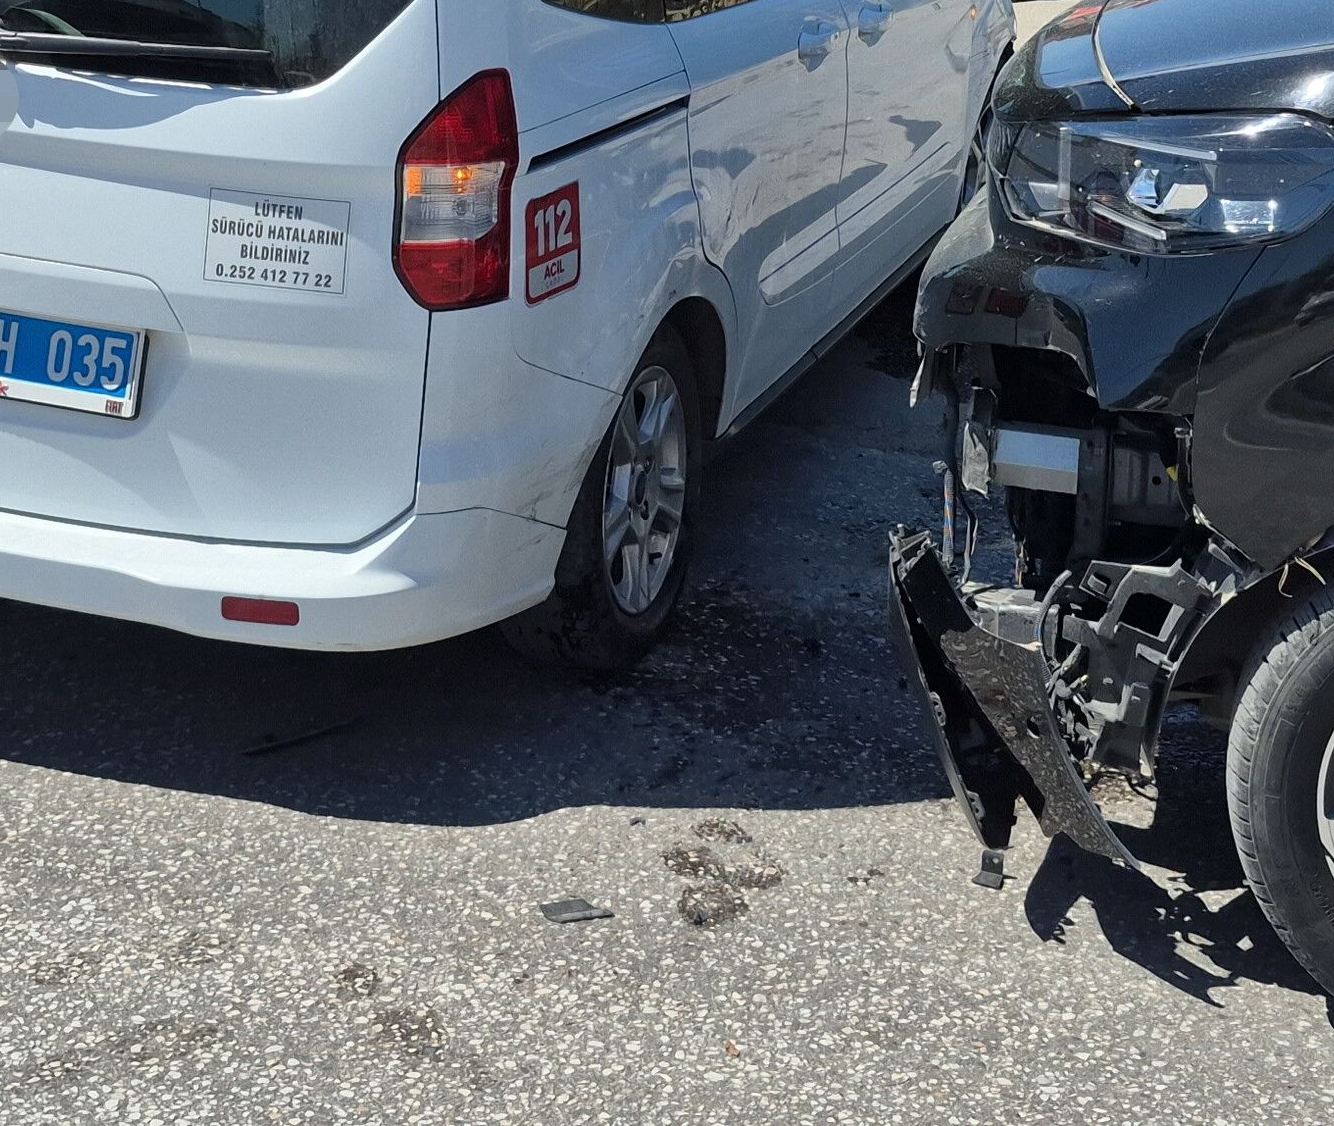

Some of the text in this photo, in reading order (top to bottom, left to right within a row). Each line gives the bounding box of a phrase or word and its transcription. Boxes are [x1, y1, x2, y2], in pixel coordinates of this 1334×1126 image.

[254, 199, 303, 221] LÜTFEN
[211, 216, 345, 247] SÜRÜCÜ HATALARINI
[534, 199, 573, 257] 112
[240, 241, 310, 265] BİLDİRİNİZ
[215, 263, 333, 288] 0.252 412 77 22
[46, 329, 129, 391] 035
[105, 398, 125, 414] FIAT
